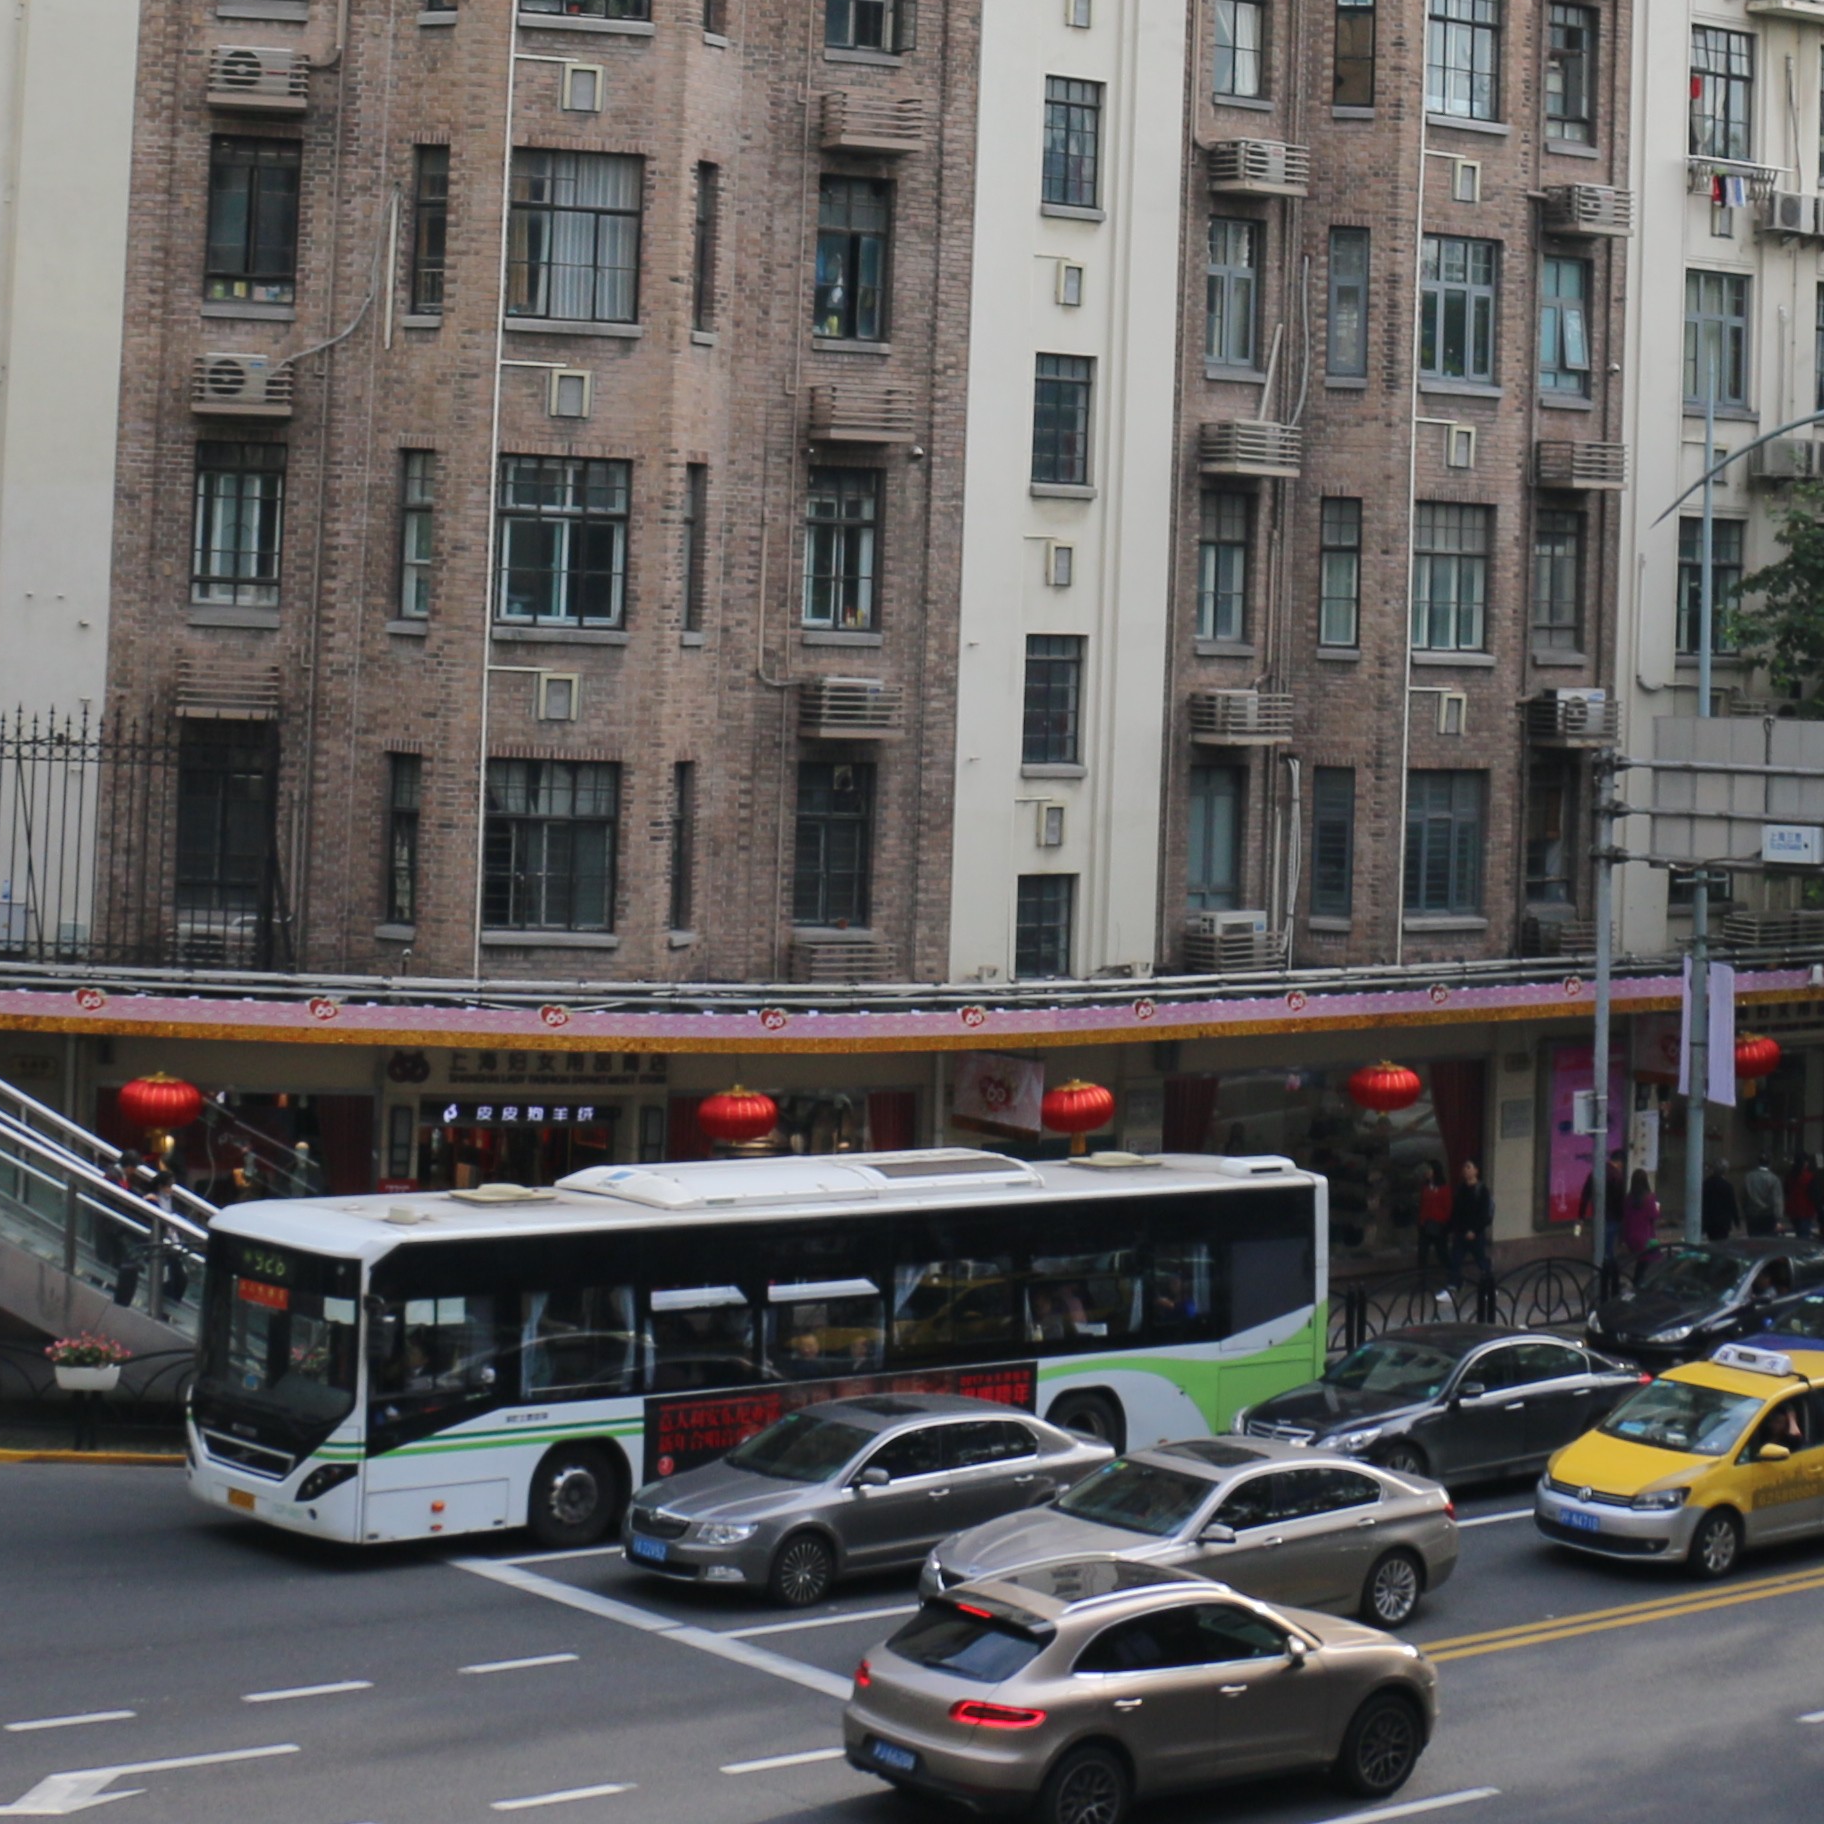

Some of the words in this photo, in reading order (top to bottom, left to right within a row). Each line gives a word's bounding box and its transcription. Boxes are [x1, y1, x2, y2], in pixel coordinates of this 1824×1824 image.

[476, 1106, 594, 1122] 皮皮狗羊绒
